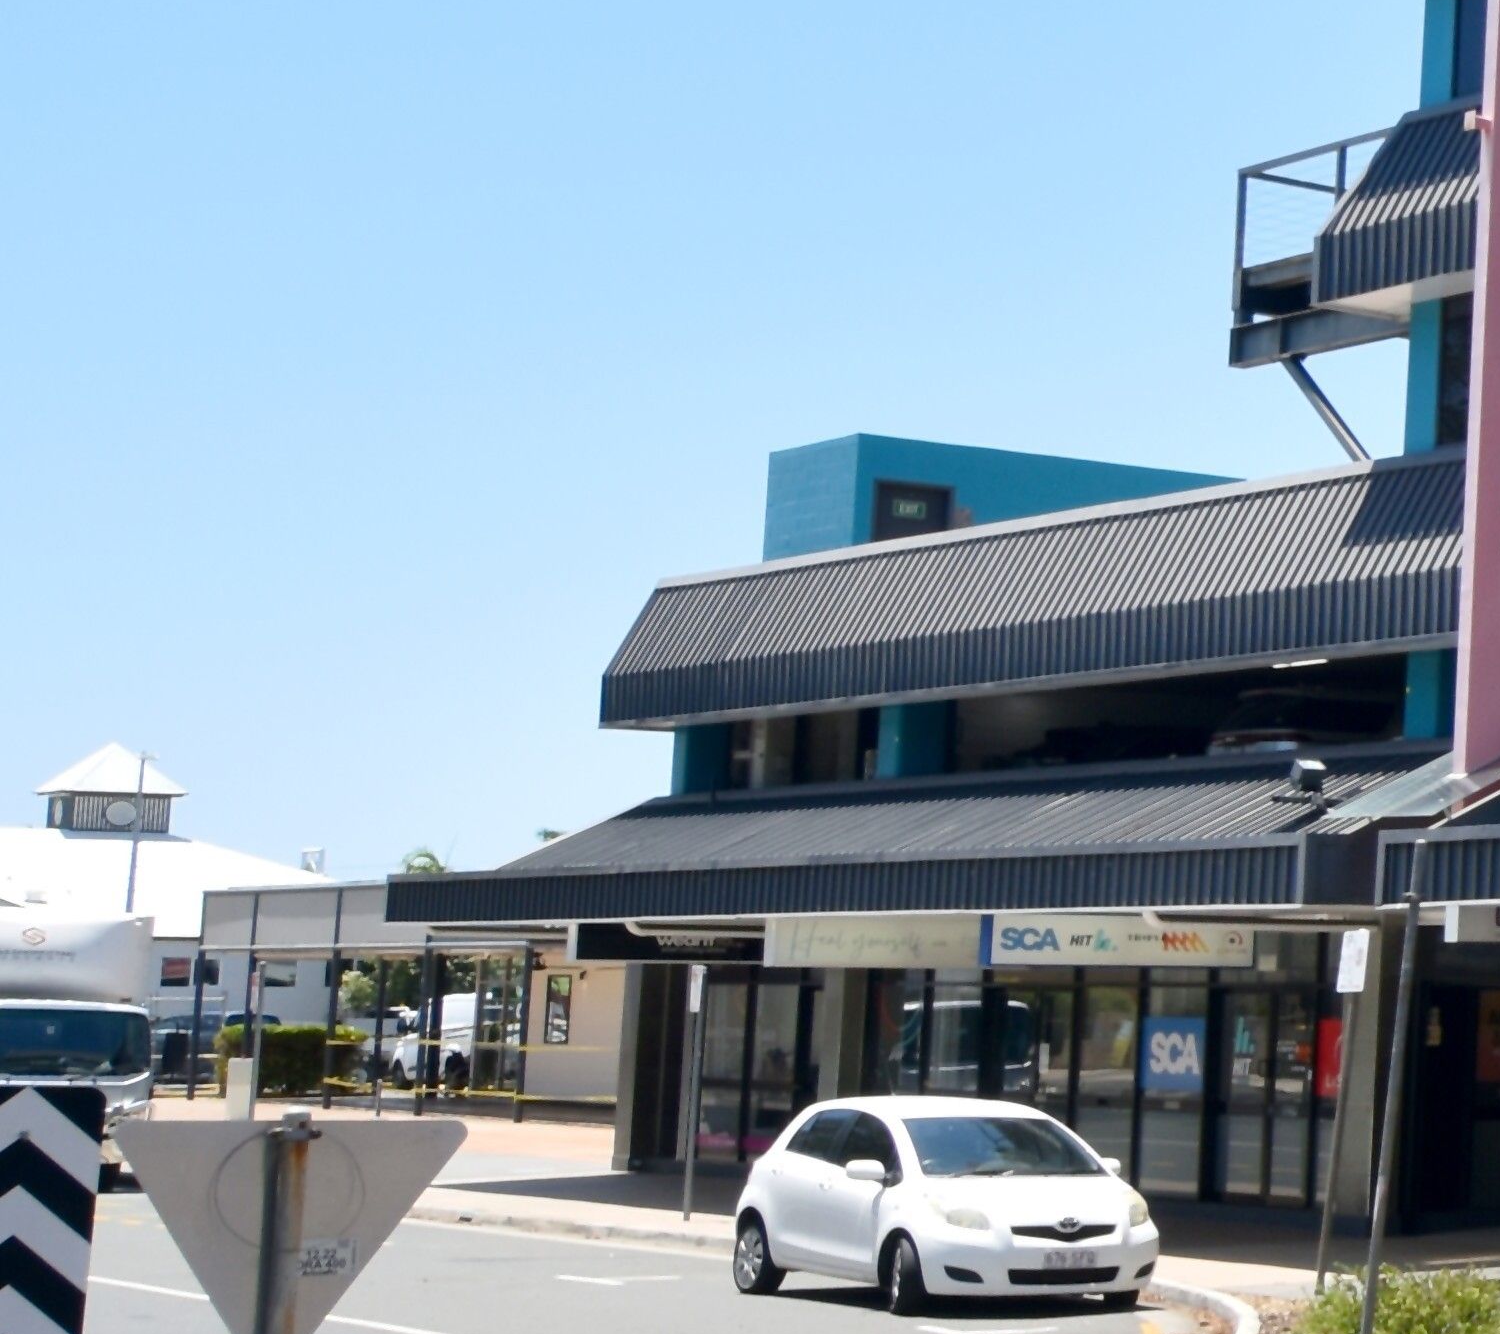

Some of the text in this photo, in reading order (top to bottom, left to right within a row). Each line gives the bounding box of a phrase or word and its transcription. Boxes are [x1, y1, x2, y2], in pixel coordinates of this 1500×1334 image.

[1001, 927, 1060, 951] SCA
[1070, 934, 1093, 946] HIT
[1150, 1032, 1200, 1074] SCA
